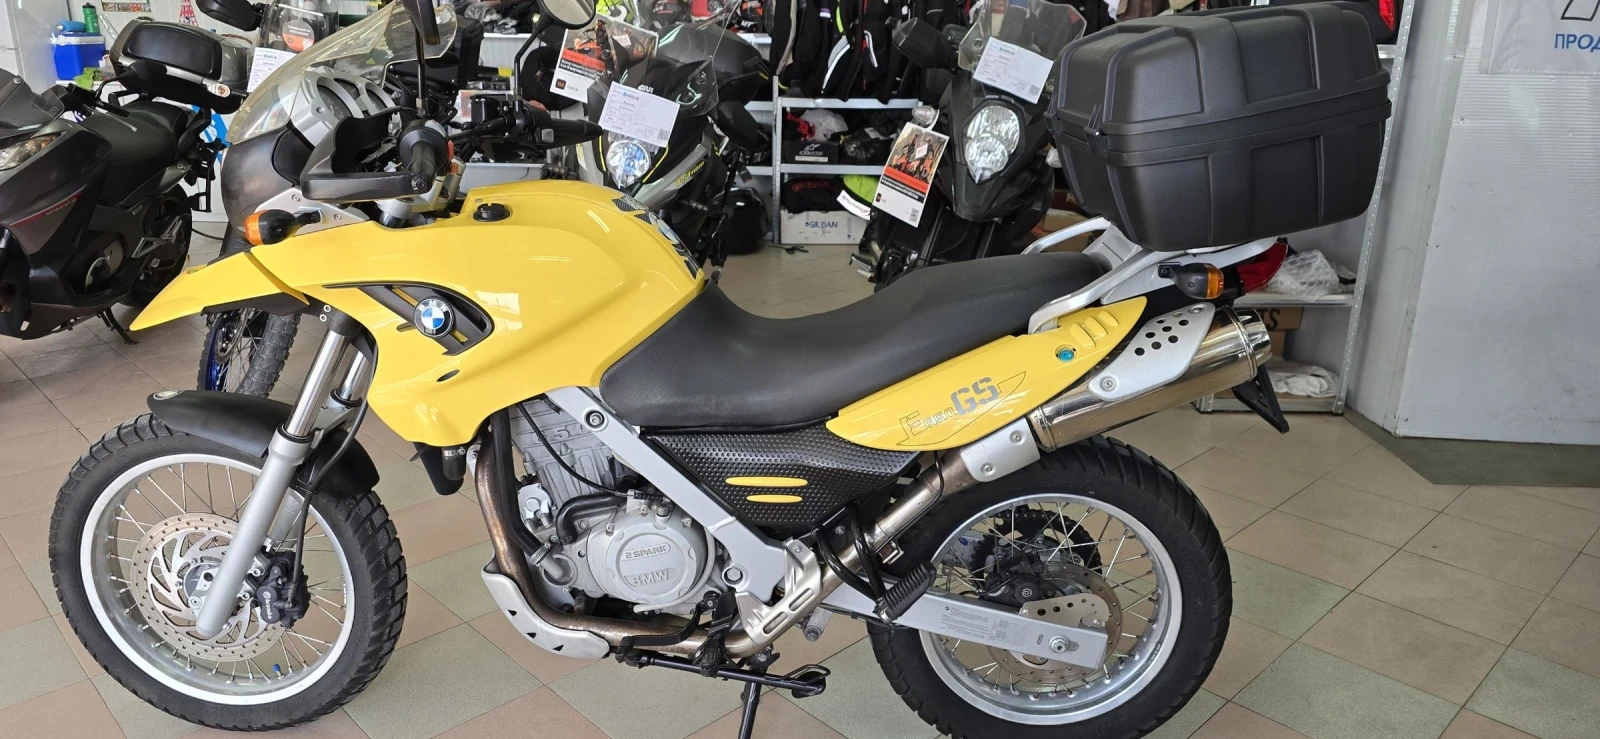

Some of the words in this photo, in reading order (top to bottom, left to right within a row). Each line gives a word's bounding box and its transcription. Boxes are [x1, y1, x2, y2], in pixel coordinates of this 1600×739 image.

[637, 84, 654, 94] GIVI
[418, 300, 450, 313] BMW
[950, 376, 999, 416] GS
[633, 544, 667, 558] SPARK
[631, 568, 669, 587] BMW
